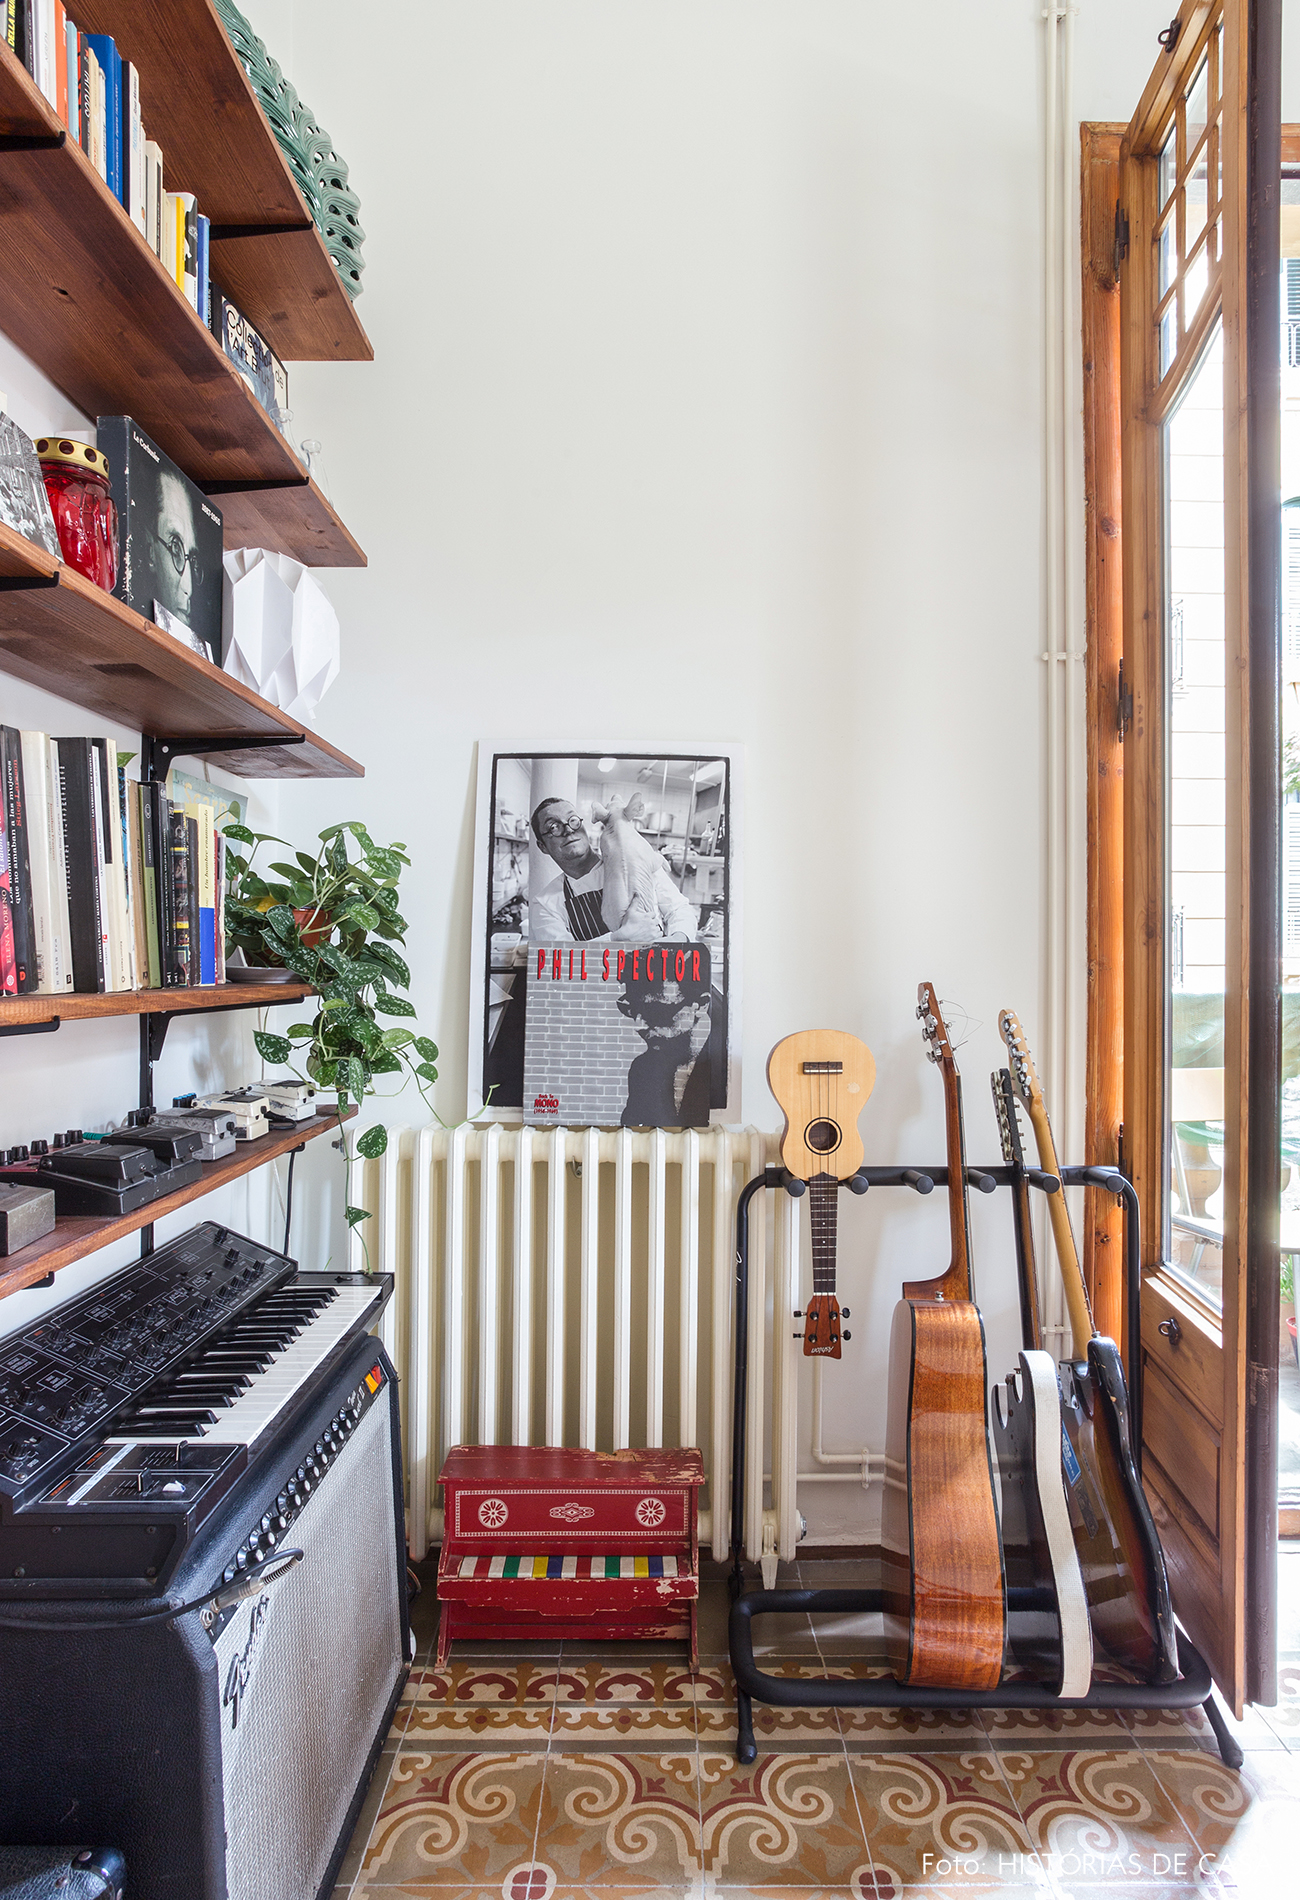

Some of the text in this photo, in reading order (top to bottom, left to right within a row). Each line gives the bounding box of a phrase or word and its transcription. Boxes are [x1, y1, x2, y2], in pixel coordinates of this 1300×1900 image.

[7, 17, 15, 46] DELLA
[227, 309, 284, 389] Collection de
[252, 354, 270, 390] Brut
[133, 430, 161, 464] Le Corbusier
[183, 782, 236, 833] Scarpa
[13, 871, 19, 884] no
[204, 879, 209, 890] Un
[1, 889, 10, 932] MORENO
[536, 948, 703, 982] PHIL SPECTOR
[533, 1098, 559, 1108] MONO
[811, 1346, 834, 1354] Ashton
